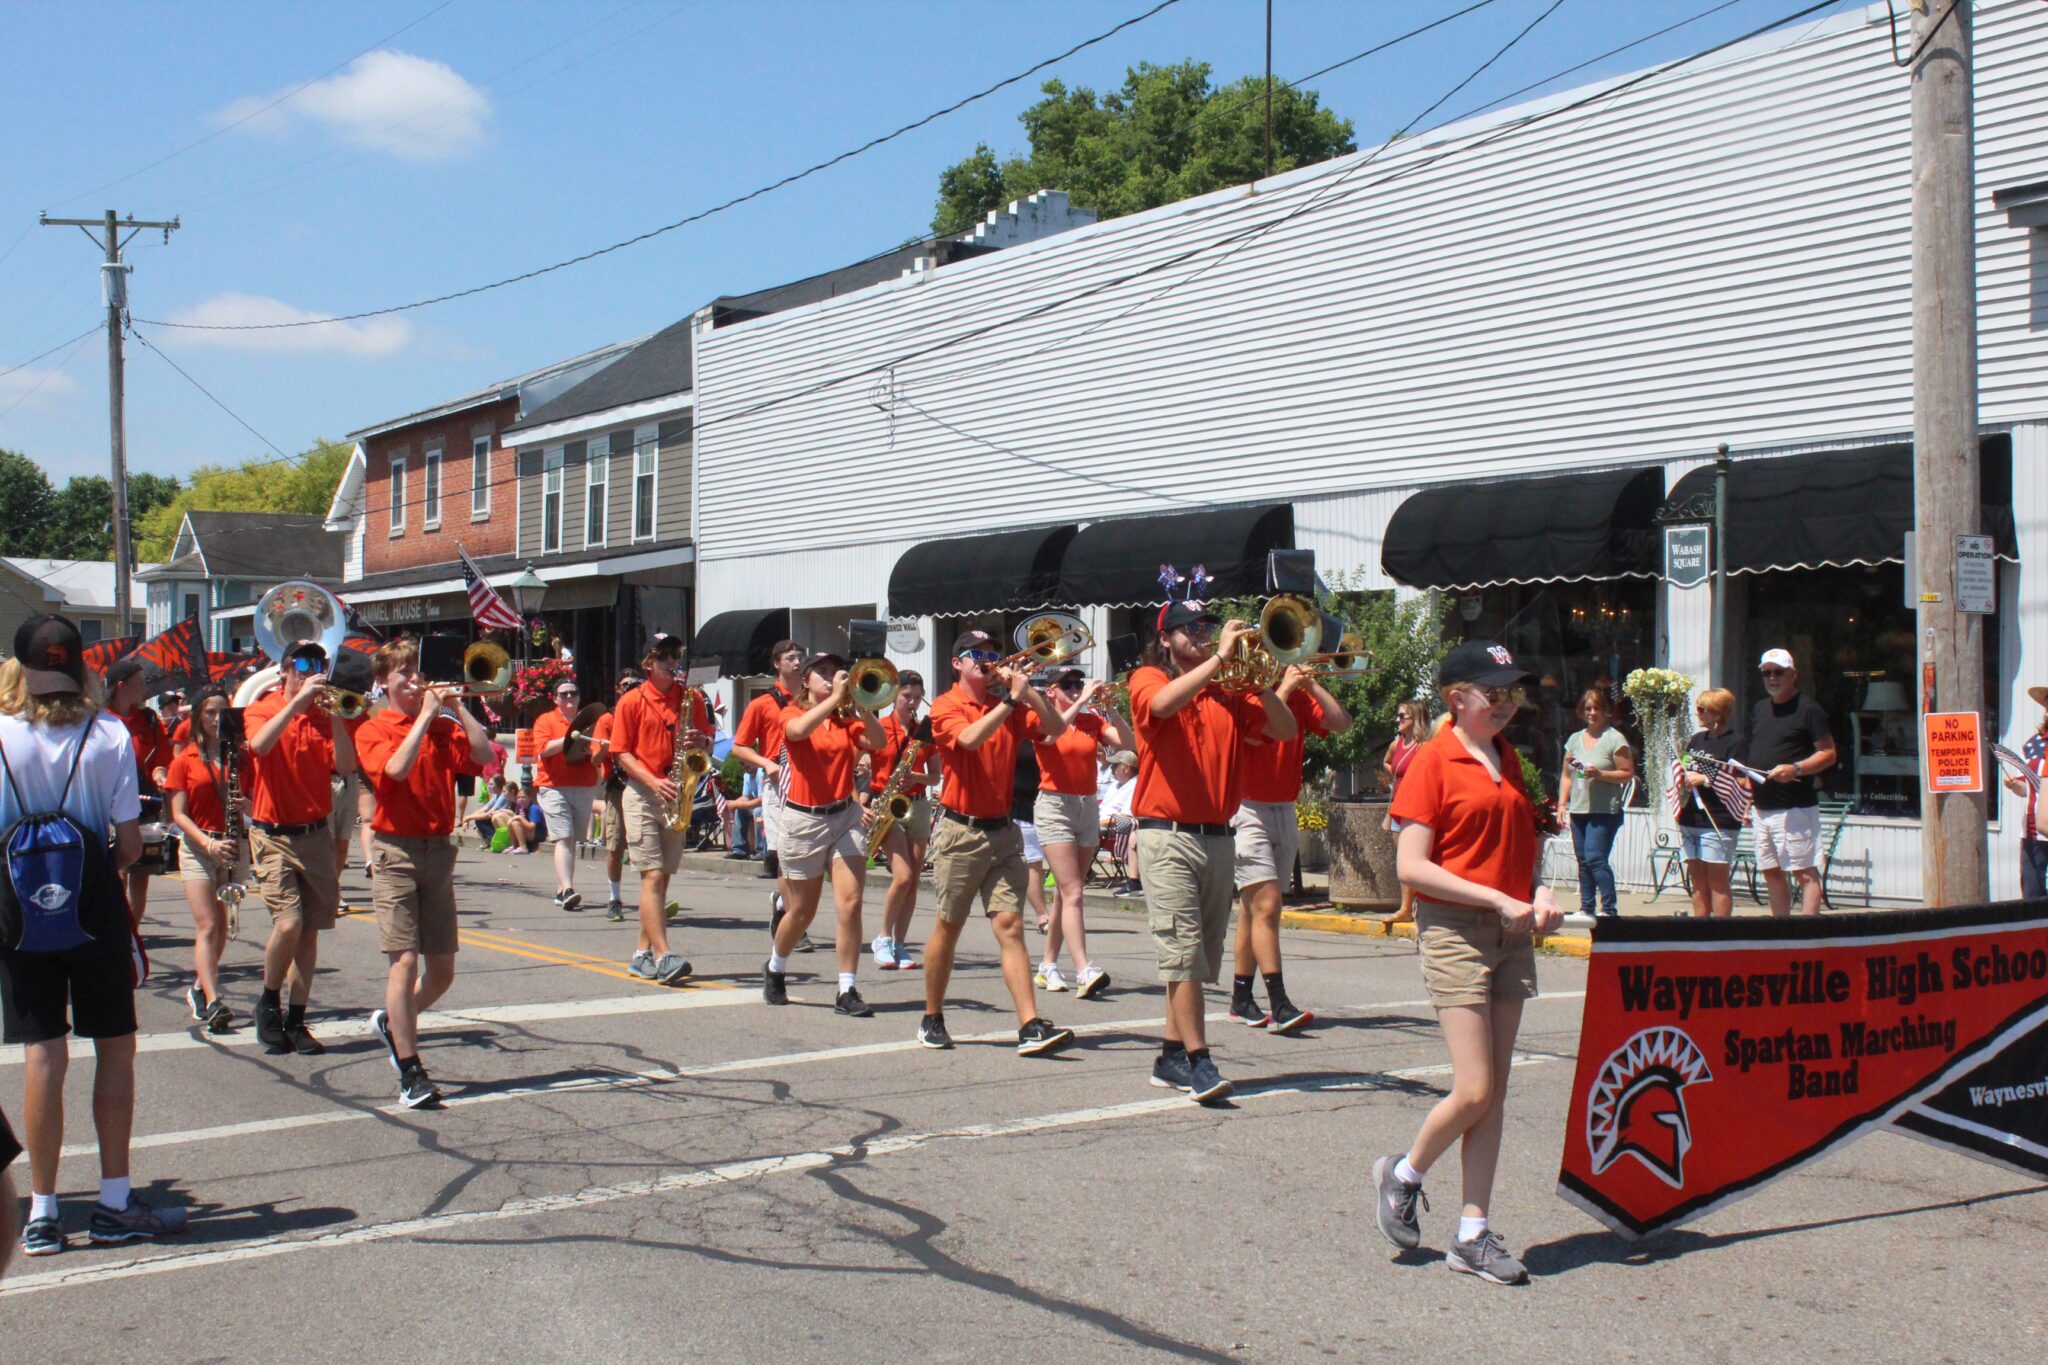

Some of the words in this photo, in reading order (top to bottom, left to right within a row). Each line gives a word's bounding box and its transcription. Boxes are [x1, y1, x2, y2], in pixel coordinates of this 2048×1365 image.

[1671, 544, 1703, 556] WABASH
[1957, 551, 1992, 559] OPERATION
[1673, 557, 1700, 570] SQUARE
[393, 600, 421, 620] HOUSE
[1945, 719, 1959, 729] NO
[1931, 730, 1974, 742] PARKING
[1931, 747, 1976, 757] TEMPORARY
[1938, 758, 1970, 767] POLICE
[1940, 768, 1969, 777] ORDER
[1618, 961, 1850, 1020] Waynesville
[1866, 952, 1944, 1006] High
[1724, 1027, 1832, 1072] Spartan
[1840, 1014, 1956, 1053] Marching
[1788, 1059, 1859, 1100] Band
